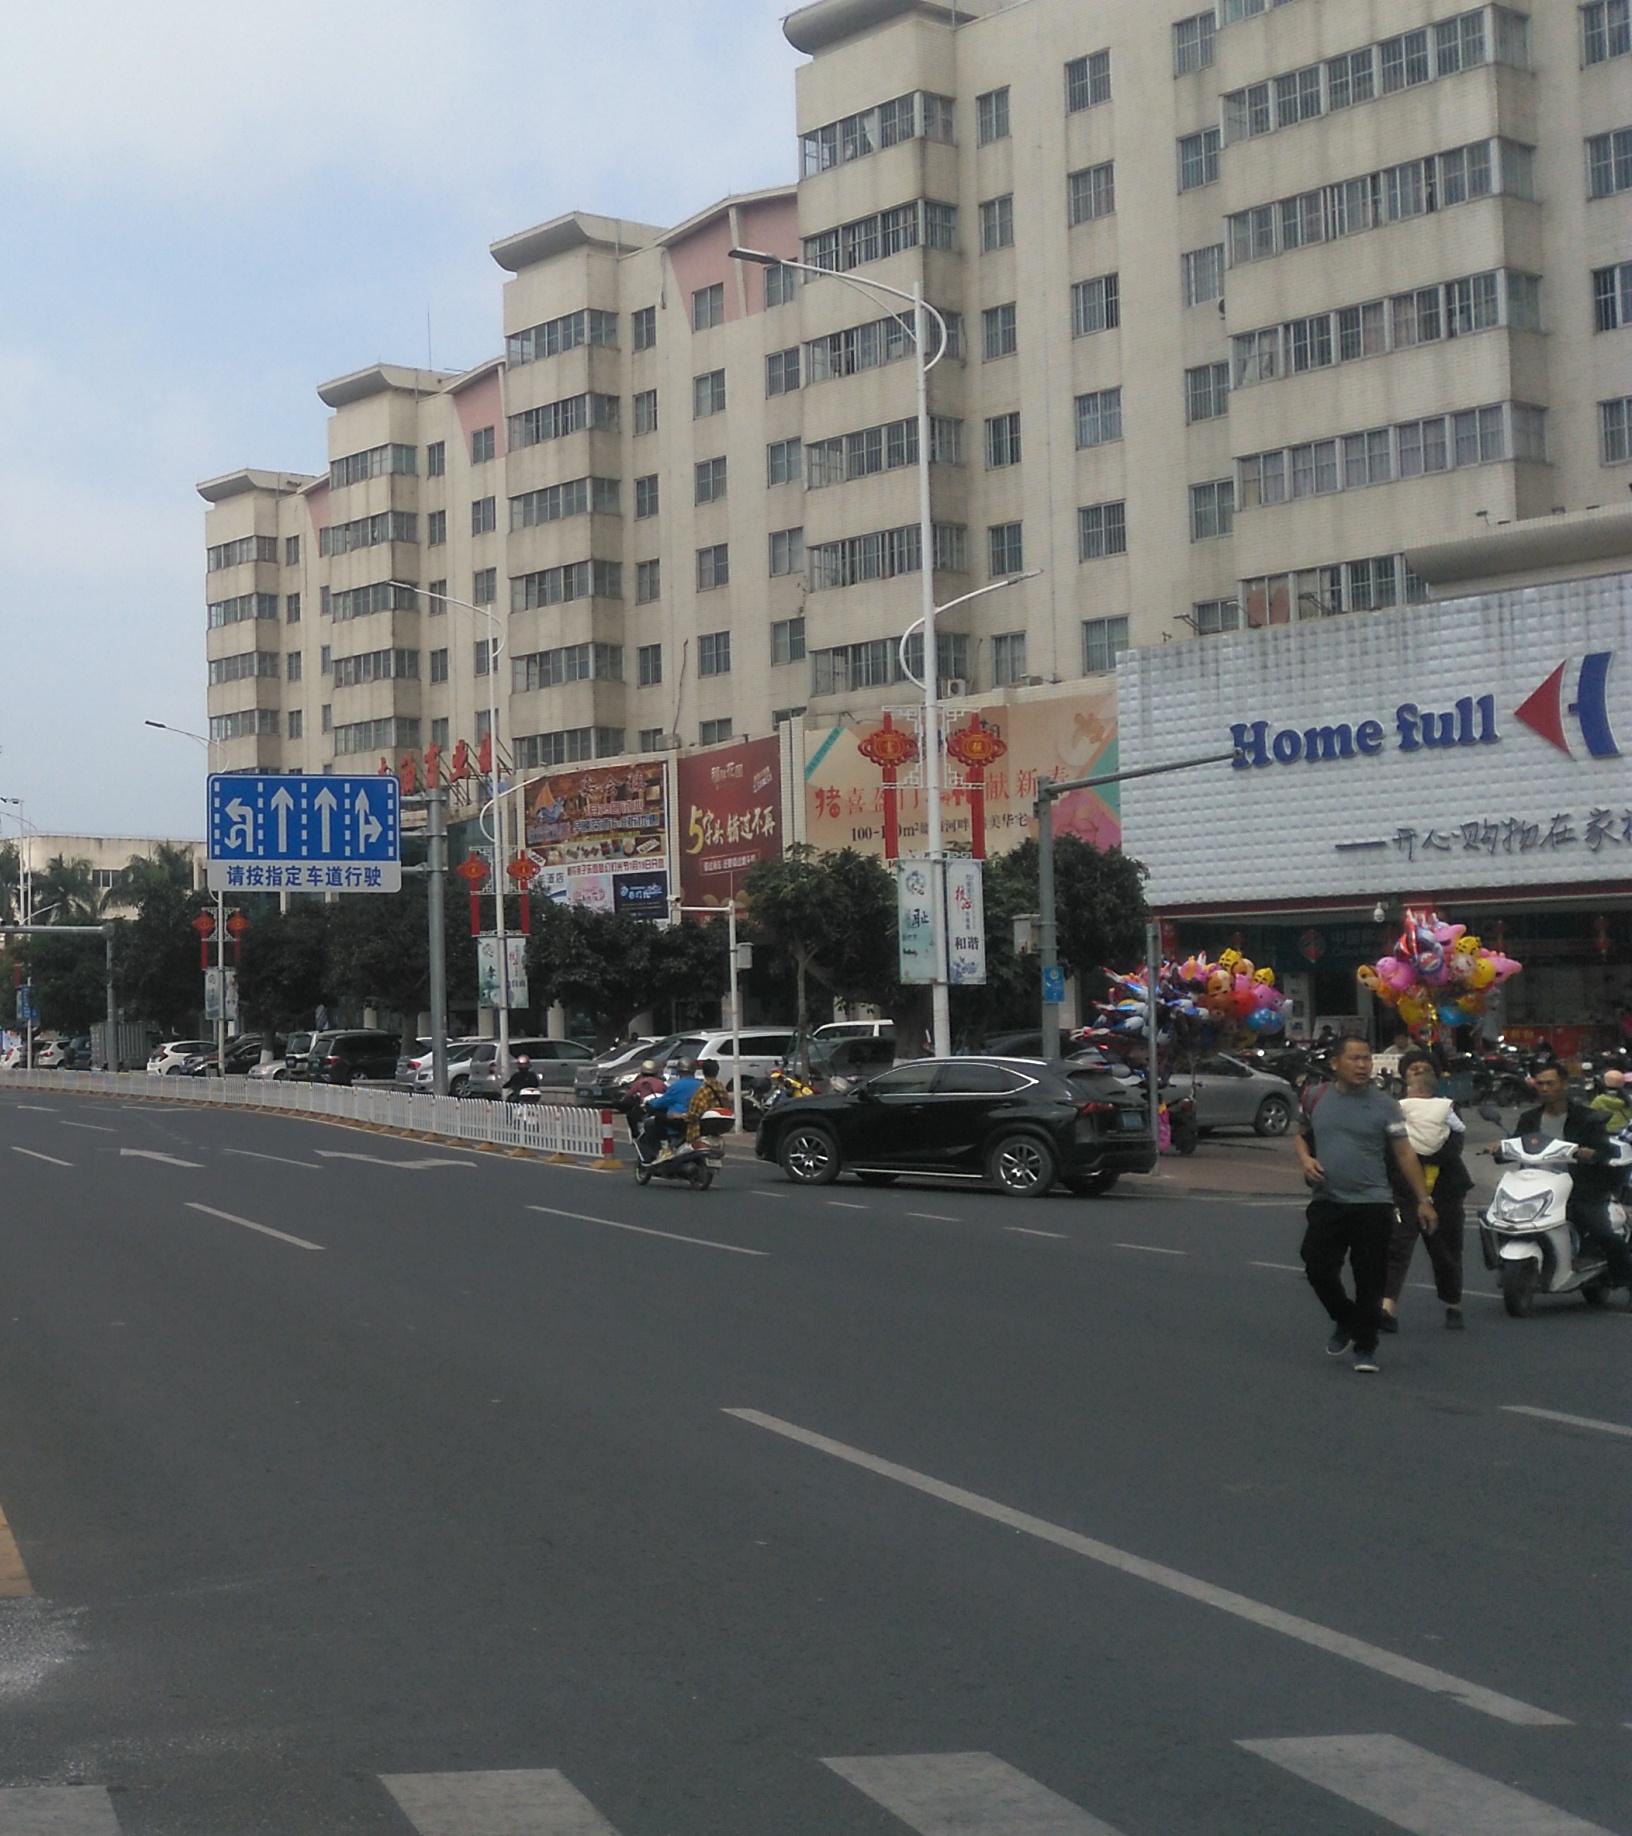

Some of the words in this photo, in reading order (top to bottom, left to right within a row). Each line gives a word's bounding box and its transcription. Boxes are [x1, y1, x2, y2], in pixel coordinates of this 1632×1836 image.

[1229, 717, 1384, 770] Home
[1396, 693, 1501, 752] full
[226, 864, 382, 888] 请按指定车道行驶
[954, 936, 980, 951] 和谐
